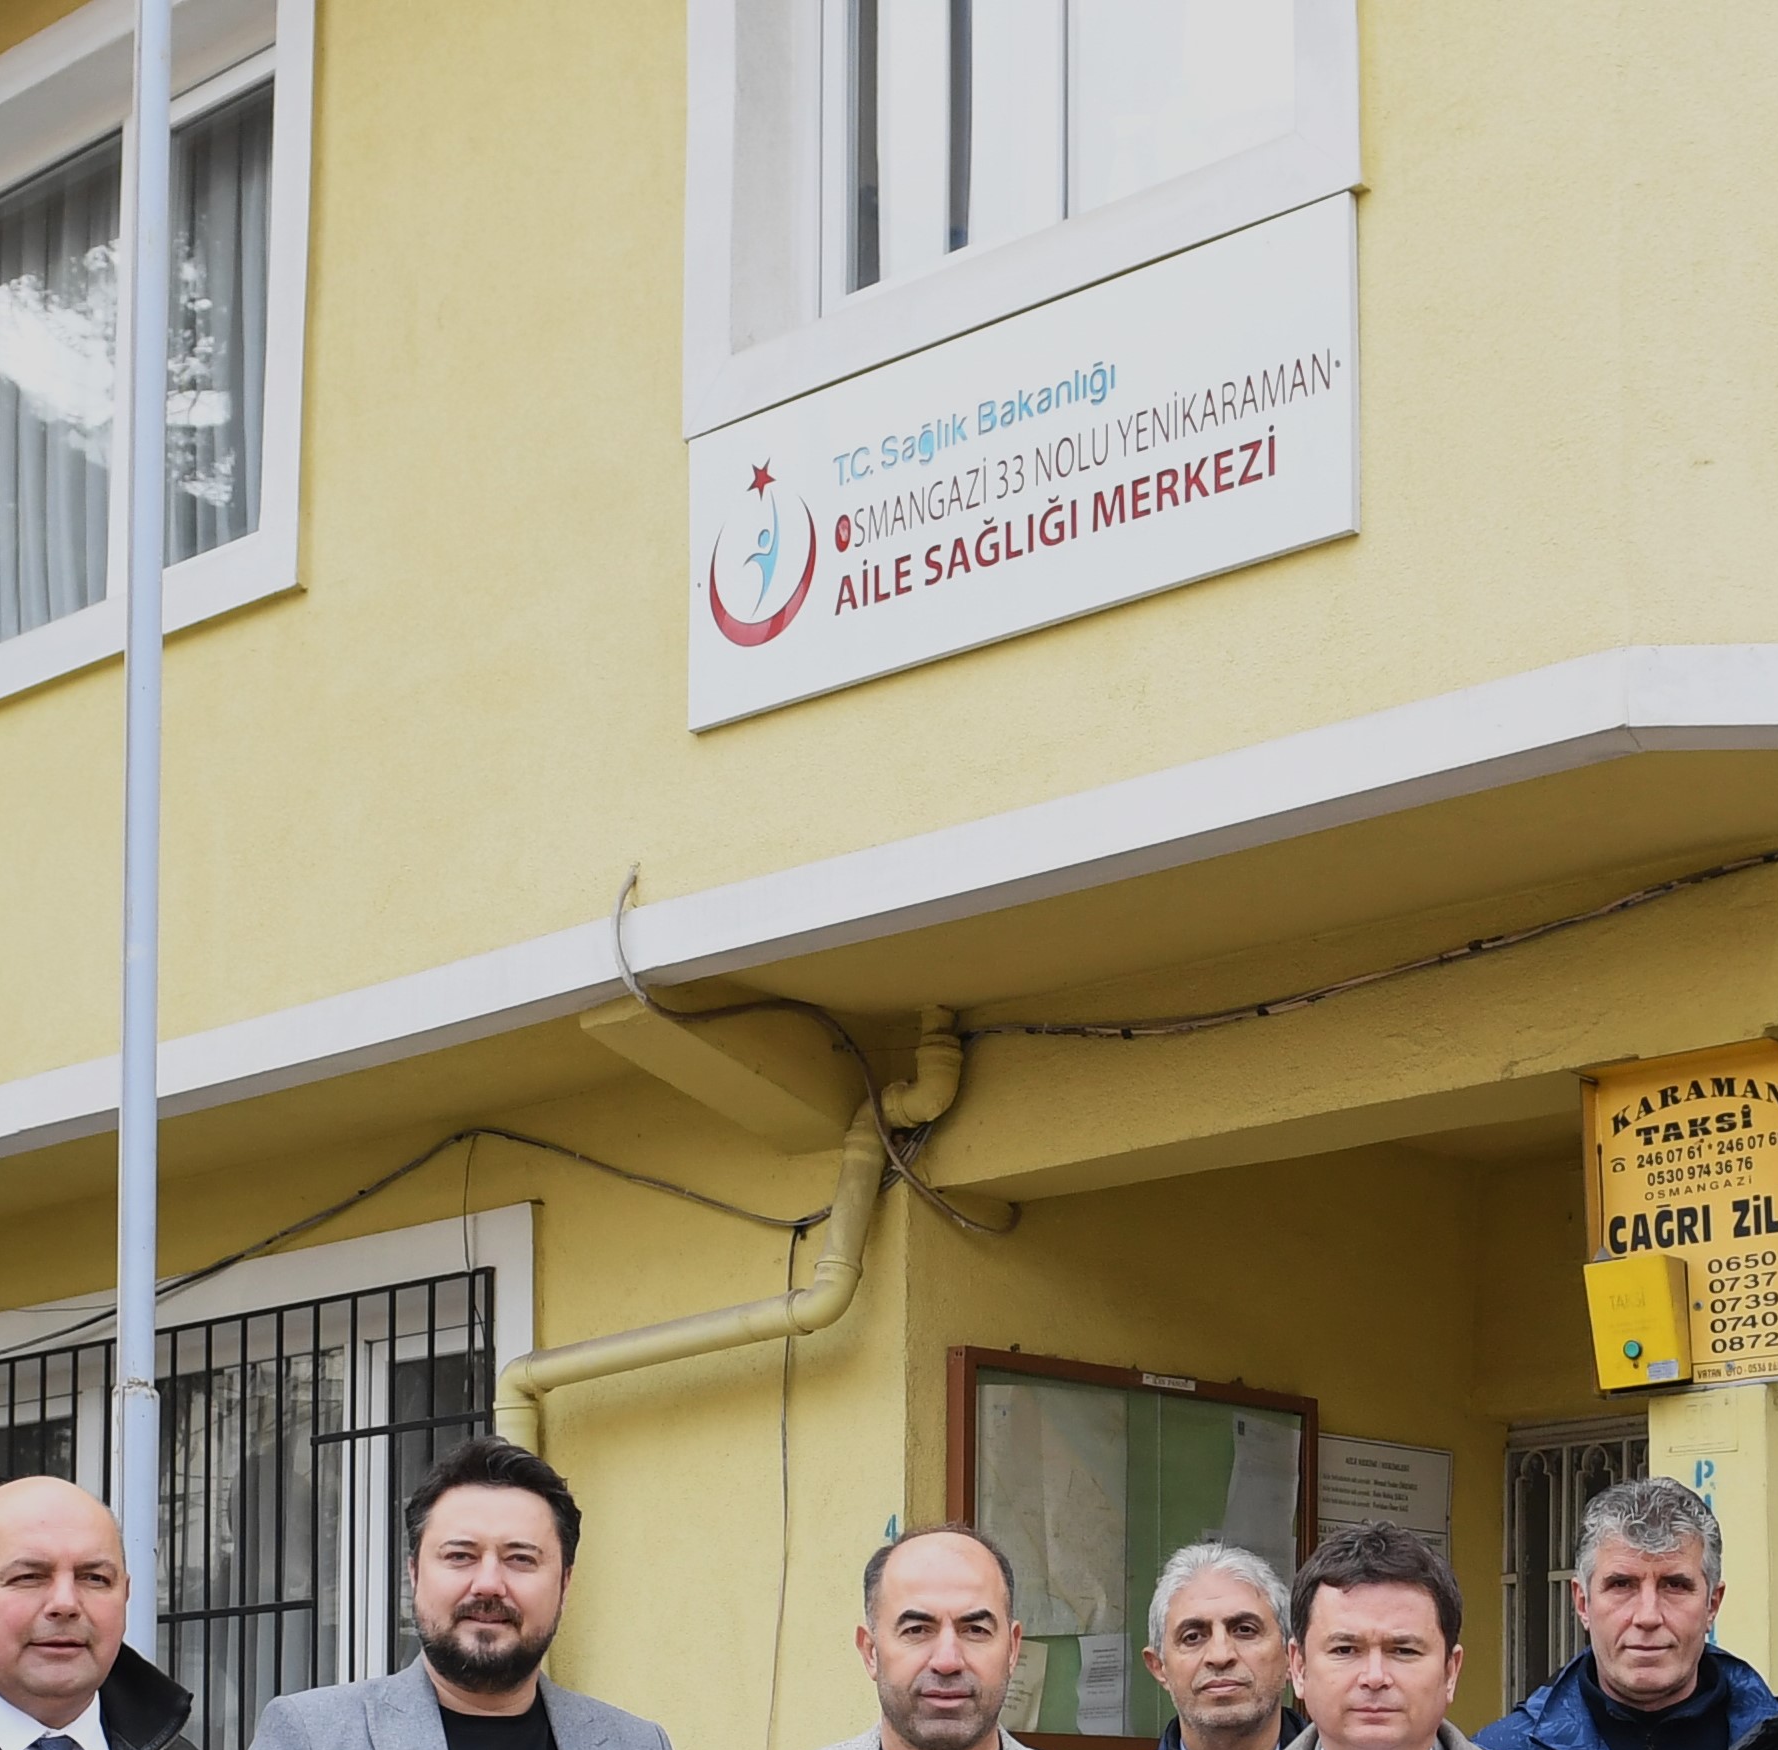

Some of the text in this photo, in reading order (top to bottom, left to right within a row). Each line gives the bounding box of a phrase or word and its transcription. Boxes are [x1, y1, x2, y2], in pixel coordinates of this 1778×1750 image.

[832, 363, 1117, 487] T.C. Sağlık Bakanlığı
[834, 348, 1332, 553] OSMANGAZİ 33 NOLU YENİKARAMAN
[834, 425, 1276, 617] AİLE SAĞLIĞI MERKEZİ
[1636, 1104, 1753, 1146] TAKSİ
[1637, 1151, 1663, 1169] 246
[1667, 1148, 1683, 1163] 07
[1687, 1145, 1702, 1160] 61
[1717, 1138, 1744, 1155] 246
[1747, 1134, 1764, 1149] 07
[1647, 1156, 1753, 1186] 0530 974 36 76
[1707, 1250, 1777, 1274] 0650
[1708, 1271, 1778, 1294] 0737
[1709, 1291, 1778, 1315] 0739
[1710, 1312, 1778, 1334] 0740
